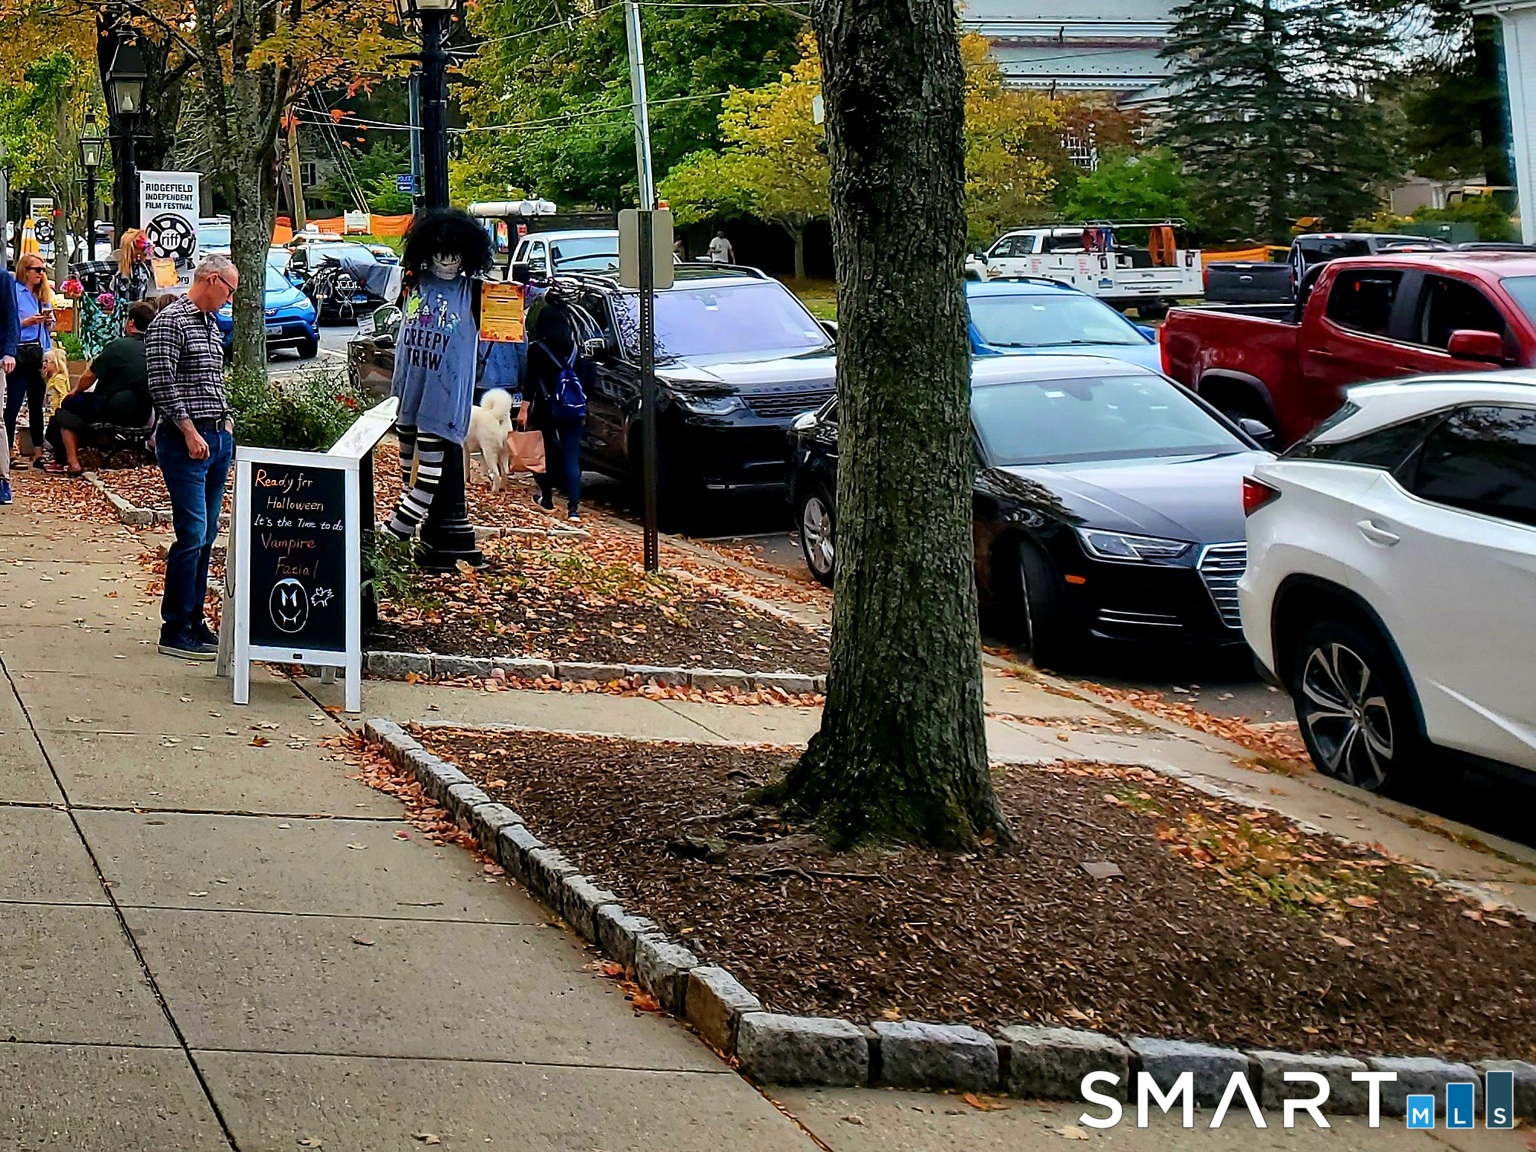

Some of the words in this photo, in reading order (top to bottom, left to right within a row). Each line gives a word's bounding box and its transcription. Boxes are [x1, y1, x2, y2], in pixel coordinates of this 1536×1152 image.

[145, 183, 193, 193] RIDGEFIELD
[145, 193, 194, 202] INDEPENDENT
[145, 201, 162, 209] FILM
[163, 202, 194, 210] FESTIVAL
[161, 233, 179, 246] riff
[404, 328, 451, 353] CREEPY
[254, 468, 294, 493] Ready
[296, 472, 313, 491] for
[266, 495, 324, 512] Halloween
[253, 514, 273, 527] It's
[276, 516, 292, 527] the
[320, 521, 331, 530] to
[332, 519, 344, 531] do
[260, 532, 316, 556] Vampire
[275, 556, 320, 579] Facial
